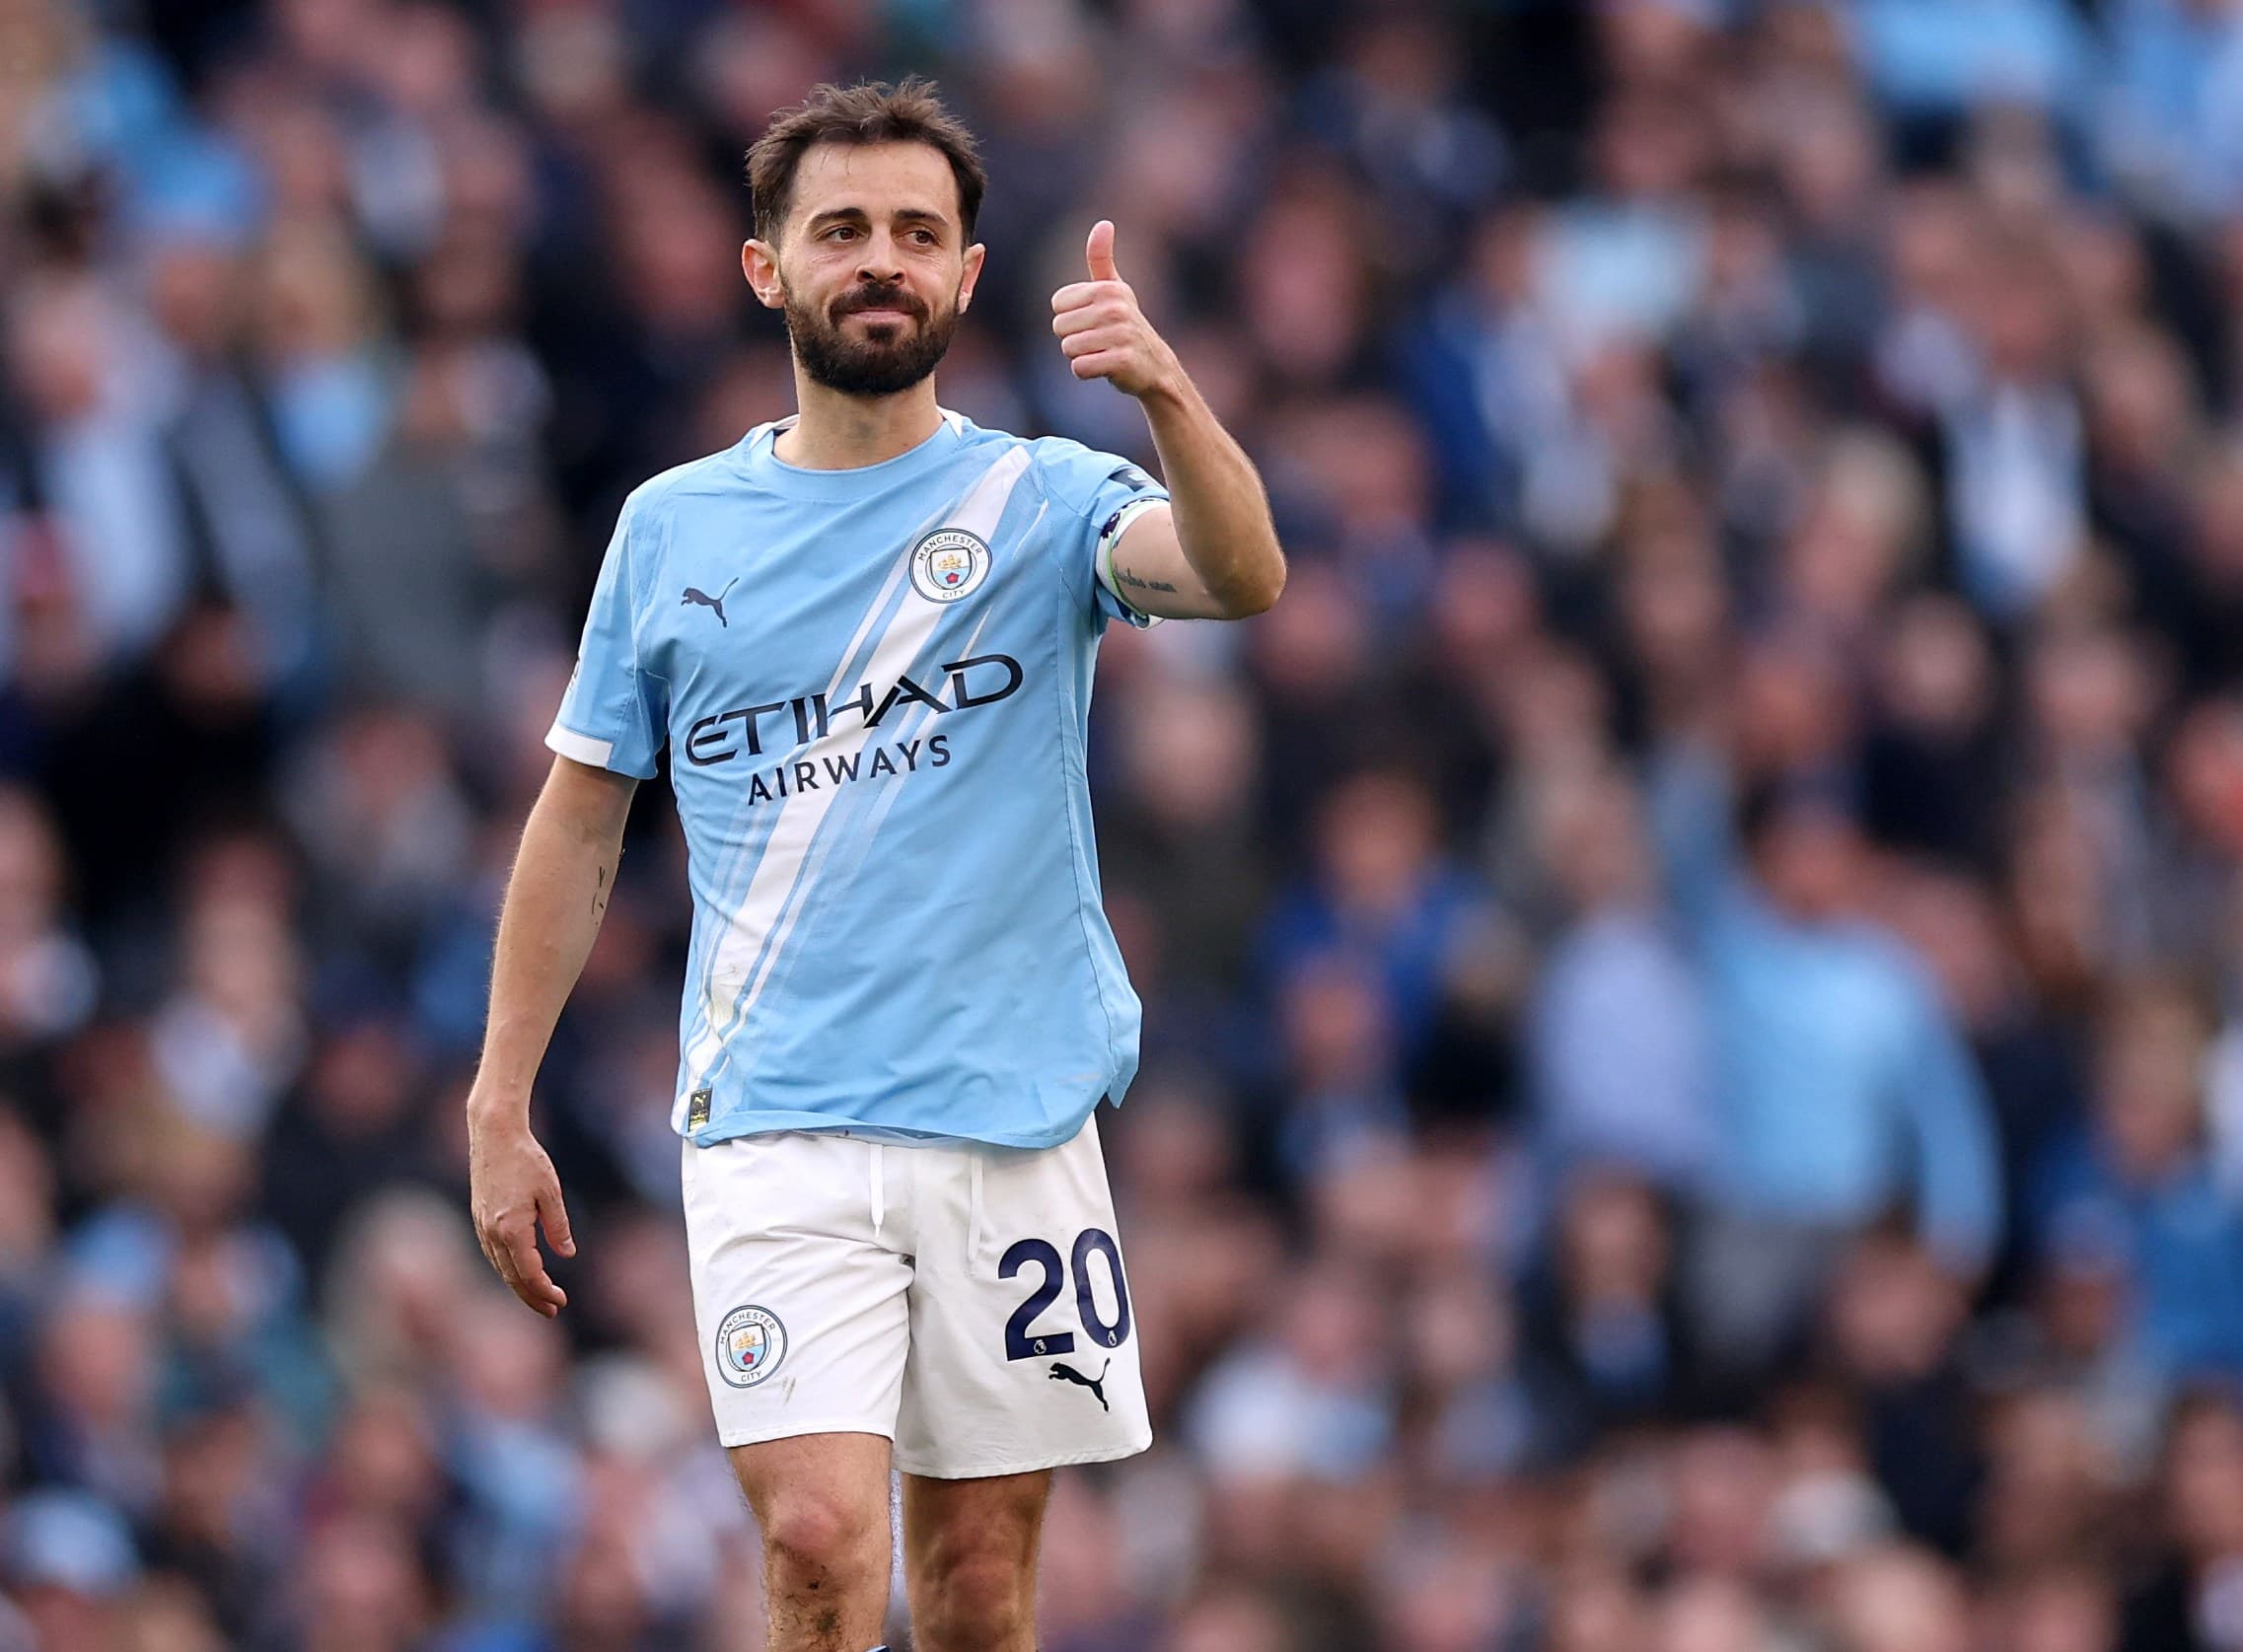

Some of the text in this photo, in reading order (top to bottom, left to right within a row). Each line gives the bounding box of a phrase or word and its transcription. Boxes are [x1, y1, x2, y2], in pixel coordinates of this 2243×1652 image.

[918, 535, 983, 561] MANCHESTER
[942, 589, 965, 599] CITY
[686, 654, 1024, 766] ETIHAD
[748, 735, 952, 806] AIRWAYS
[998, 1228, 1131, 1362] 20
[720, 1311, 776, 1344] MANCHESTER
[741, 1371, 761, 1383] CITY
